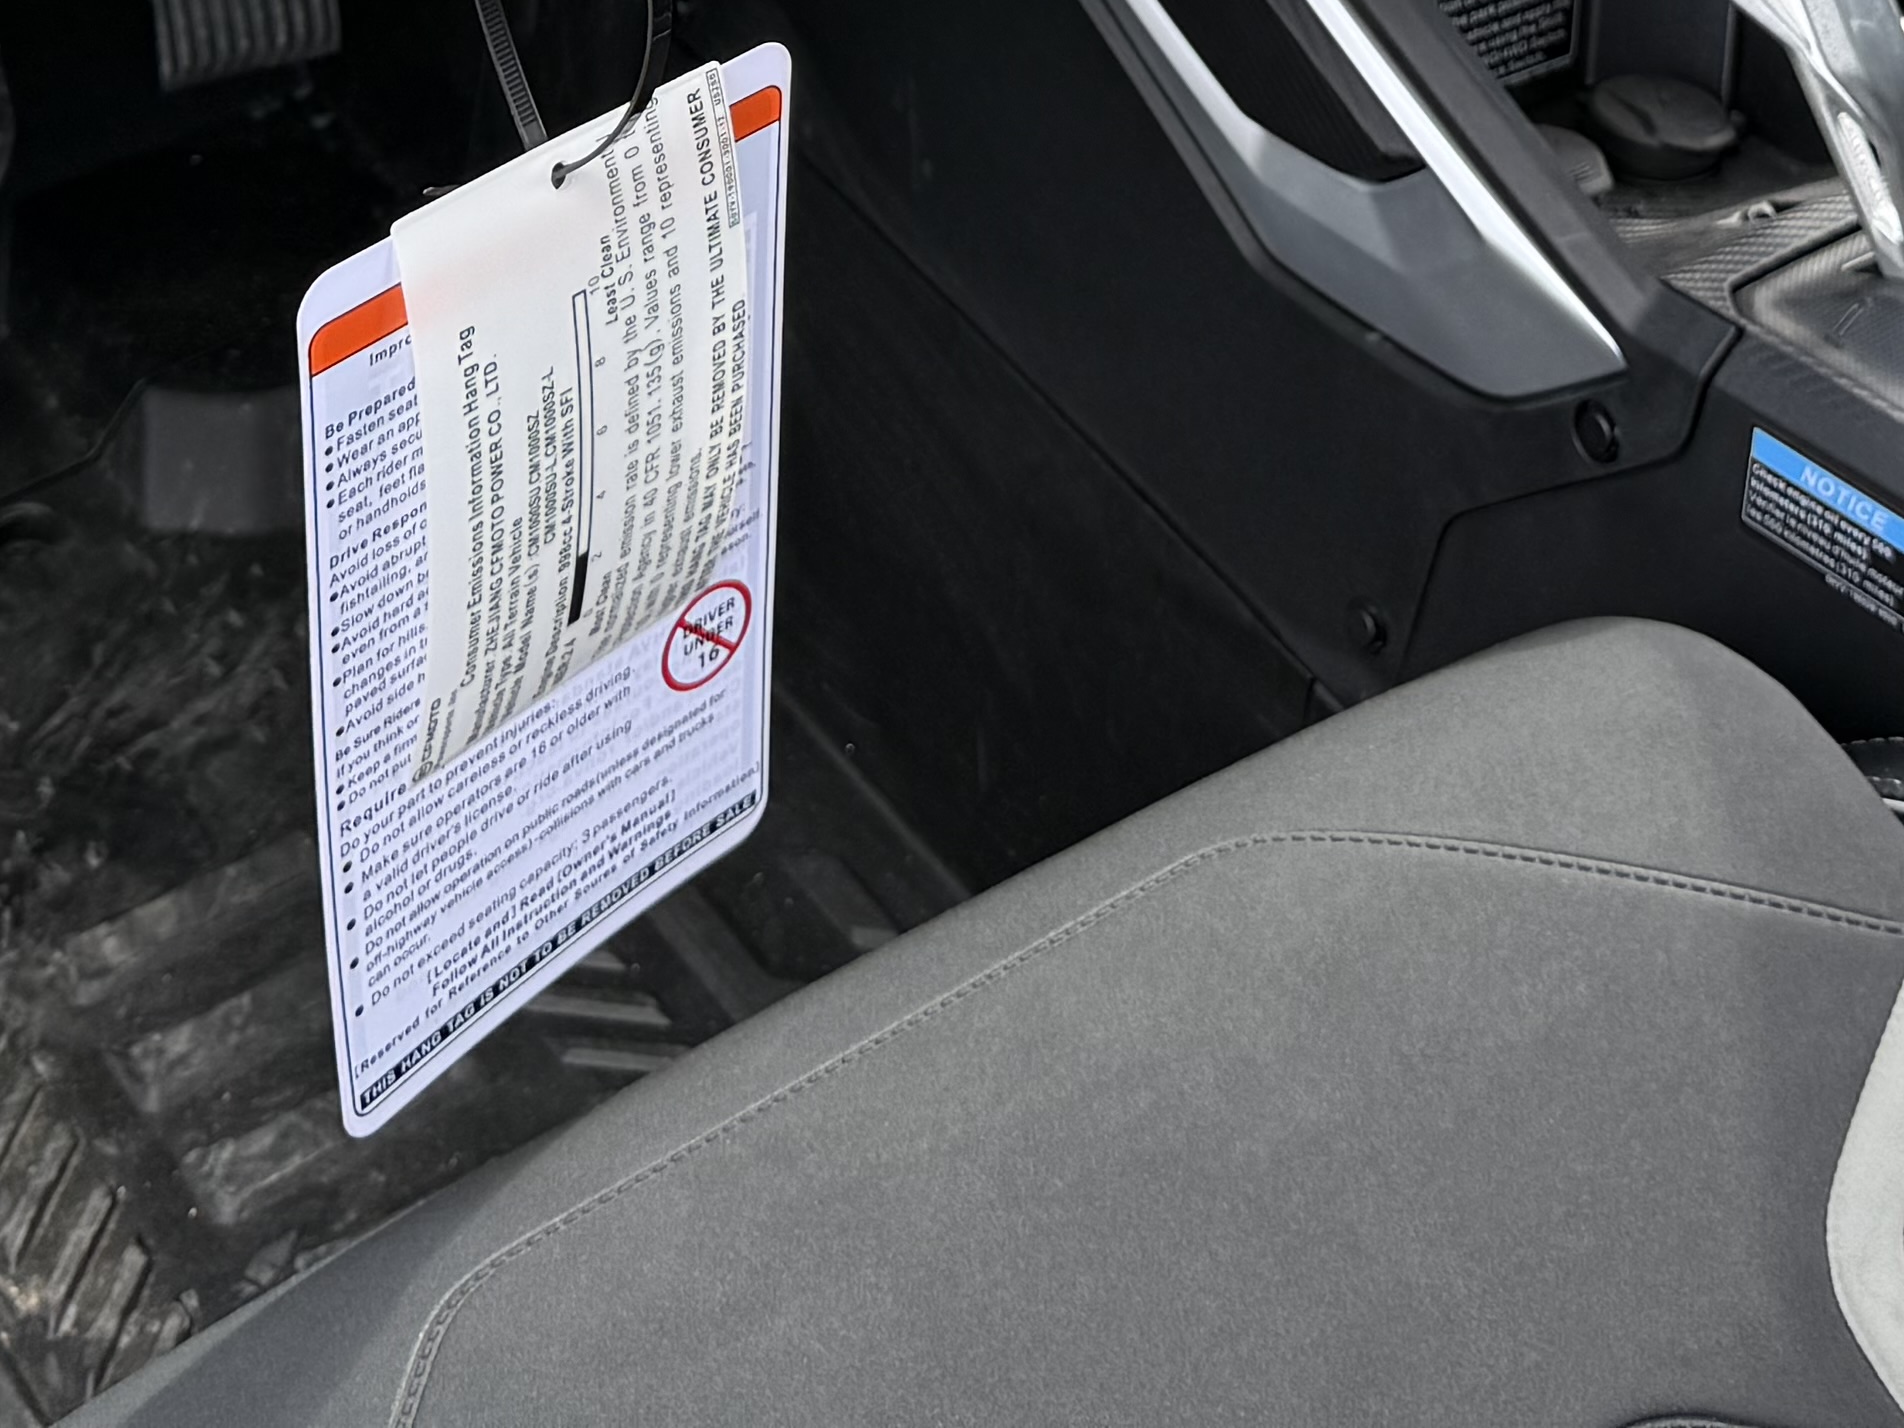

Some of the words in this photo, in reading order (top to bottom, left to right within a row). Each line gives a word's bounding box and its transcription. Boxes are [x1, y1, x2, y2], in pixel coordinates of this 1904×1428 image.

[686, 88, 715, 185] CONSUMER
[631, 164, 648, 207] from
[638, 212, 656, 263] range
[659, 216, 676, 239] 10
[703, 190, 723, 271] ULTIMATE
[599, 234, 614, 278] Clean
[662, 244, 680, 278] and
[587, 274, 600, 296] 10
[603, 282, 618, 325] Least
[643, 268, 659, 329] Values
[710, 274, 725, 310] THE
[457, 325, 475, 365] Tag
[622, 314, 637, 344] the
[669, 283, 683, 365] emissions
[711, 313, 726, 336] BY
[731, 299, 745, 393] PURCHASED
[482, 353, 499, 397] LTD.
[593, 355, 606, 368] 8
[623, 347, 642, 372] by
[710, 339, 726, 414] REMOVED
[324, 421, 344, 440] Be
[347, 376, 415, 426] Prepared
[462, 362, 479, 416] Hang
[559, 387, 574, 418] SFI
[623, 374, 639, 434] defined
[669, 369, 684, 433] exhaust
[336, 415, 384, 451] Fasten
[561, 417, 574, 459] With
[595, 424, 608, 436] 6
[709, 415, 724, 439] BE
[728, 395, 743, 437] BEEN
[336, 439, 373, 468] Wear
[337, 450, 386, 487] Always
[465, 415, 483, 521] Information
[488, 437, 504, 505] POWER
[623, 438, 639, 457] is
[643, 446, 660, 484] CFR
[665, 439, 682, 482] lower
[705, 442, 721, 480] ONLY
[724, 438, 740, 470] HAS
[337, 476, 373, 505] Each
[375, 454, 408, 482] rider
[378, 472, 405, 498] feet
[560, 458, 574, 524] 4-Stroke
[595, 489, 606, 499] 4
[624, 458, 639, 491] rate
[1799, 465, 1890, 533] NOTICE
[337, 523, 352, 540] or
[489, 505, 504, 576] CFMOTO
[507, 516, 522, 576] Vehicle
[619, 494, 635, 559] emission
[328, 553, 368, 588] Avoid
[371, 535, 400, 560] loss
[402, 521, 417, 540] of
[329, 538, 368, 570] Drive
[466, 520, 483, 609] Emissions
[590, 550, 602, 562] 2
[339, 564, 378, 598] Avoid
[340, 603, 374, 632] Slow
[376, 579, 413, 609] down
[502, 575, 520, 631] Terrain
[338, 616, 380, 651] Avoid
[483, 576, 503, 656] ZHEJIANG
[682, 593, 735, 642] DRIVER
[683, 611, 734, 660] UNDER
[459, 609, 481, 687] Consumer
[697, 640, 719, 672] 16
[339, 836, 360, 859] Do
[363, 810, 394, 844] your
[397, 787, 425, 819] part
[428, 777, 442, 794] to
[444, 736, 498, 785] prevent
[359, 841, 380, 863] Do
[382, 820, 405, 846] not
[408, 794, 444, 827] allow
[447, 751, 505, 798] careless
[508, 738, 522, 755] or
[525, 698, 582, 744] reckless
[361, 849, 399, 883] Make
[402, 824, 432, 853] sure
[435, 774, 501, 828] operators
[503, 756, 527, 780] are
[531, 739, 546, 759] 16
[549, 730, 563, 747] or
[566, 705, 600, 735] older
[603, 685, 630, 709] with
[363, 899, 383, 921] Do
[385, 877, 408, 903] not
[410, 862, 428, 885] let
[431, 829, 477, 872] people
[480, 802, 513, 832] drive
[516, 788, 530, 806] or
[533, 769, 559, 794] ride
[561, 745, 592, 774] after
[595, 719, 632, 750] using
[362, 888, 371, 902] a
[375, 857, 408, 891] valid
[411, 821, 461, 865] driver's
[408, 890, 440, 922] allow
[443, 845, 501, 894] operation
[364, 889, 414, 937] alcohol
[416, 878, 431, 896] or
[362, 1066, 396, 1108] THIS
[400, 1027, 441, 1074] HANG
[446, 1001, 474, 1035] TAG
[479, 984, 494, 1008] IS
[499, 957, 528, 992] NOT
[534, 937, 552, 963] TO
[556, 918, 576, 946] BE
[581, 863, 649, 927] REMOVED
[654, 820, 711, 872] BEFORE
[715, 791, 752, 830] SALE
[370, 984, 390, 1006] Do
[392, 963, 414, 988] not
[416, 922, 465, 968] exceed
[468, 886, 516, 929] seating
